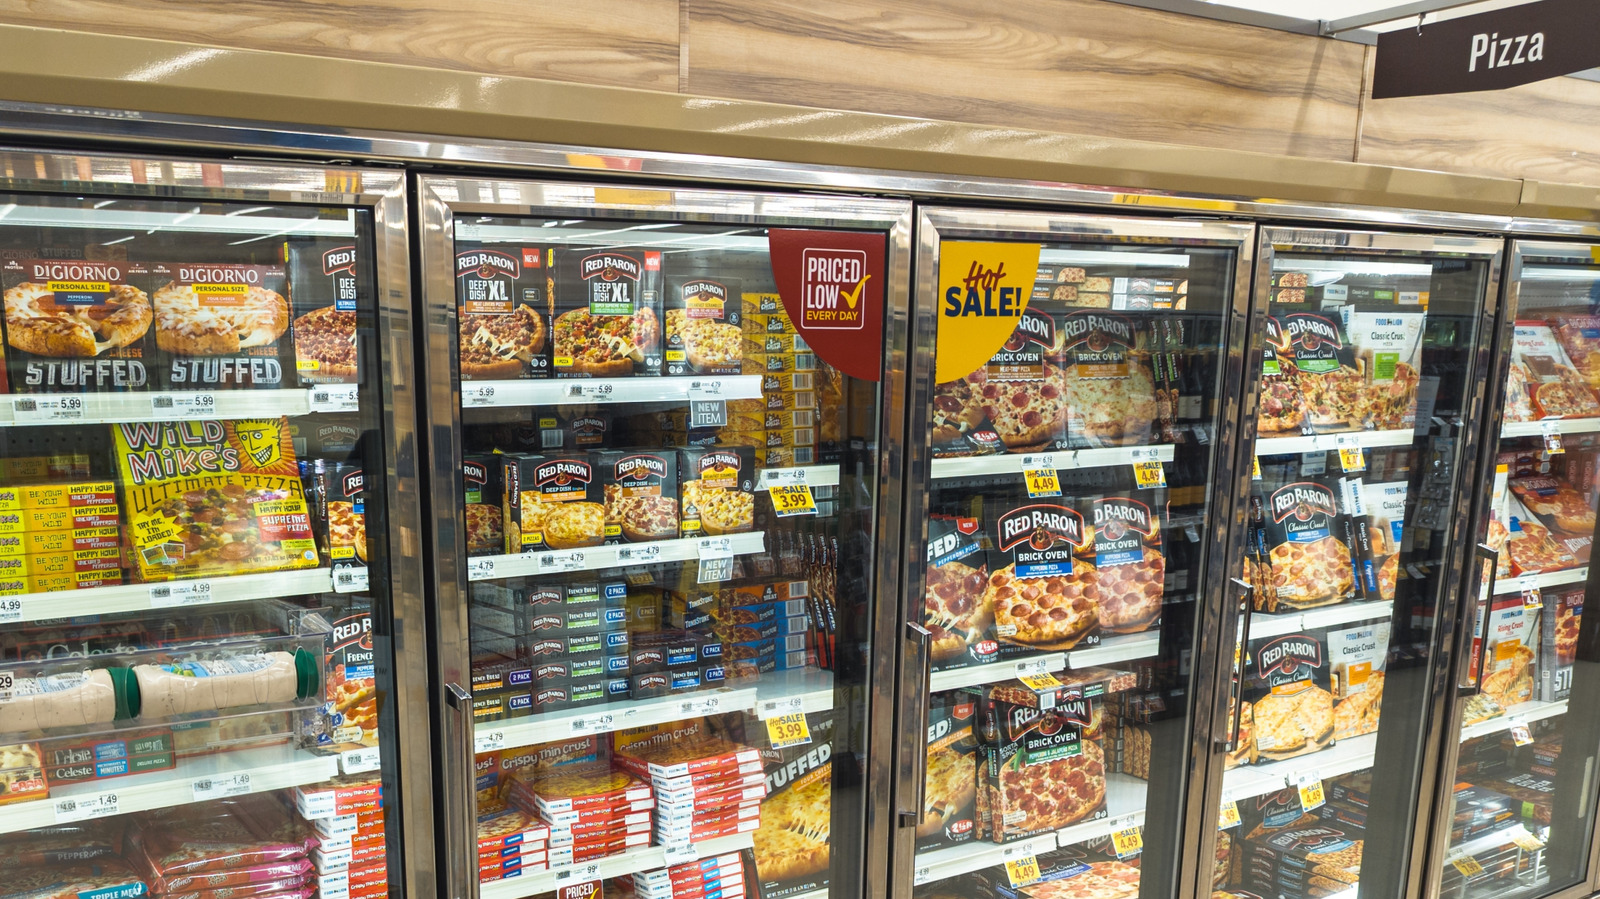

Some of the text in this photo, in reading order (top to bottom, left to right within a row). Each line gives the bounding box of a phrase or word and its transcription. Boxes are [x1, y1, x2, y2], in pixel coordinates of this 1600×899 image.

[1469, 32, 1544, 72] Pizza
[328, 253, 350, 268] RED
[458, 254, 514, 272] RED BARON
[524, 255, 538, 264] NEW
[586, 256, 636, 272] RED BARON
[807, 257, 860, 284] PRICED
[963, 260, 1006, 292] Hot
[91, 283, 106, 292] SIZE
[468, 279, 486, 290] DEEP
[488, 280, 508, 300] XL
[593, 282, 610, 292] DEEP
[684, 283, 724, 296] RED BARON
[469, 290, 486, 300] DISH
[594, 292, 610, 302] DISH
[611, 282, 630, 302] XL
[806, 284, 838, 310] LOW
[944, 286, 1022, 318] SALE!
[806, 311, 858, 322] EVERY DAY
[1064, 314, 1130, 340] RED BARON
[1300, 317, 1336, 342] BARON
[1370, 331, 1388, 342] Classic
[990, 352, 1038, 362] BRICK OVEN
[1078, 353, 1122, 362] BRICK OVEN
[1296, 349, 1334, 360] Classic Crust
[26, 360, 146, 386] STUFFED
[171, 358, 282, 384] STUFFED
[479, 387, 494, 396] 5.99
[598, 385, 612, 394] 5.99
[61, 398, 80, 408] 5.99
[195, 396, 214, 406] 5.99
[697, 403, 720, 412] NEW
[697, 412, 722, 424] ITEM
[618, 458, 664, 472] RED BARON
[701, 454, 738, 468] RED BARON
[1144, 462, 1162, 472] SALE!
[538, 464, 588, 480] RED BARON
[1036, 469, 1056, 478] SALE!
[1141, 471, 1160, 484] 4.49
[98, 484, 112, 492] HOUR
[783, 485, 808, 494] SALE!
[1032, 479, 1054, 492] 4.49
[132, 474, 302, 514] ULTIMATE PIZZA
[1275, 487, 1330, 514] RED BARON
[782, 494, 806, 508] 3.99
[1382, 499, 1402, 510] Classic
[260, 503, 302, 514] HAPPY HOUR
[1104, 503, 1146, 526] BARON
[47, 511, 66, 520] YOUR
[261, 514, 306, 526] SUPREME
[286, 523, 308, 532] PIZZA
[1003, 511, 1078, 540] RED BARON
[1287, 519, 1326, 532] Classic Crust
[141, 529, 174, 546] LOADED!
[1095, 538, 1138, 552] BRICK OVEN
[938, 542, 980, 568] PEPPERONI PIZZA
[1019, 550, 1068, 562] BRICK OVEN
[705, 560, 726, 570] NEW
[104, 570, 120, 578] HOUR
[704, 569, 726, 582] ITEM
[192, 583, 210, 592] 4.99
[612, 586, 624, 594] PACK
[0, 600, 20, 610] 4.99
[333, 622, 360, 642] RED
[1497, 620, 1524, 632] Rising Crust
[614, 635, 626, 644] PACK
[1342, 641, 1376, 656] Classic Crust
[1262, 641, 1316, 670] RED BARON
[517, 672, 530, 680] PACK
[1272, 672, 1310, 688] Classic Crust
[517, 697, 530, 706] PACK
[779, 713, 804, 724] SALE!
[651, 723, 698, 744] Thin Crust
[777, 723, 802, 738] 3.99
[929, 731, 964, 752] CHEESE PIZZA
[1028, 731, 1076, 750] BRICK OVEN
[501, 736, 592, 770] Crispy Thin Crust
[55, 766, 92, 780] Celeste
[100, 766, 124, 776] MINUTES!
[763, 747, 832, 794] TUFFED
[232, 775, 250, 786] 1.49
[99, 794, 116, 806] 1.49
[1305, 792, 1322, 806] 4.49
[1119, 836, 1138, 850] 4.49
[1015, 857, 1034, 868] SALE!
[1460, 859, 1478, 876] 7.99
[1014, 865, 1036, 882] 4.49
[566, 883, 594, 896] PRICED
